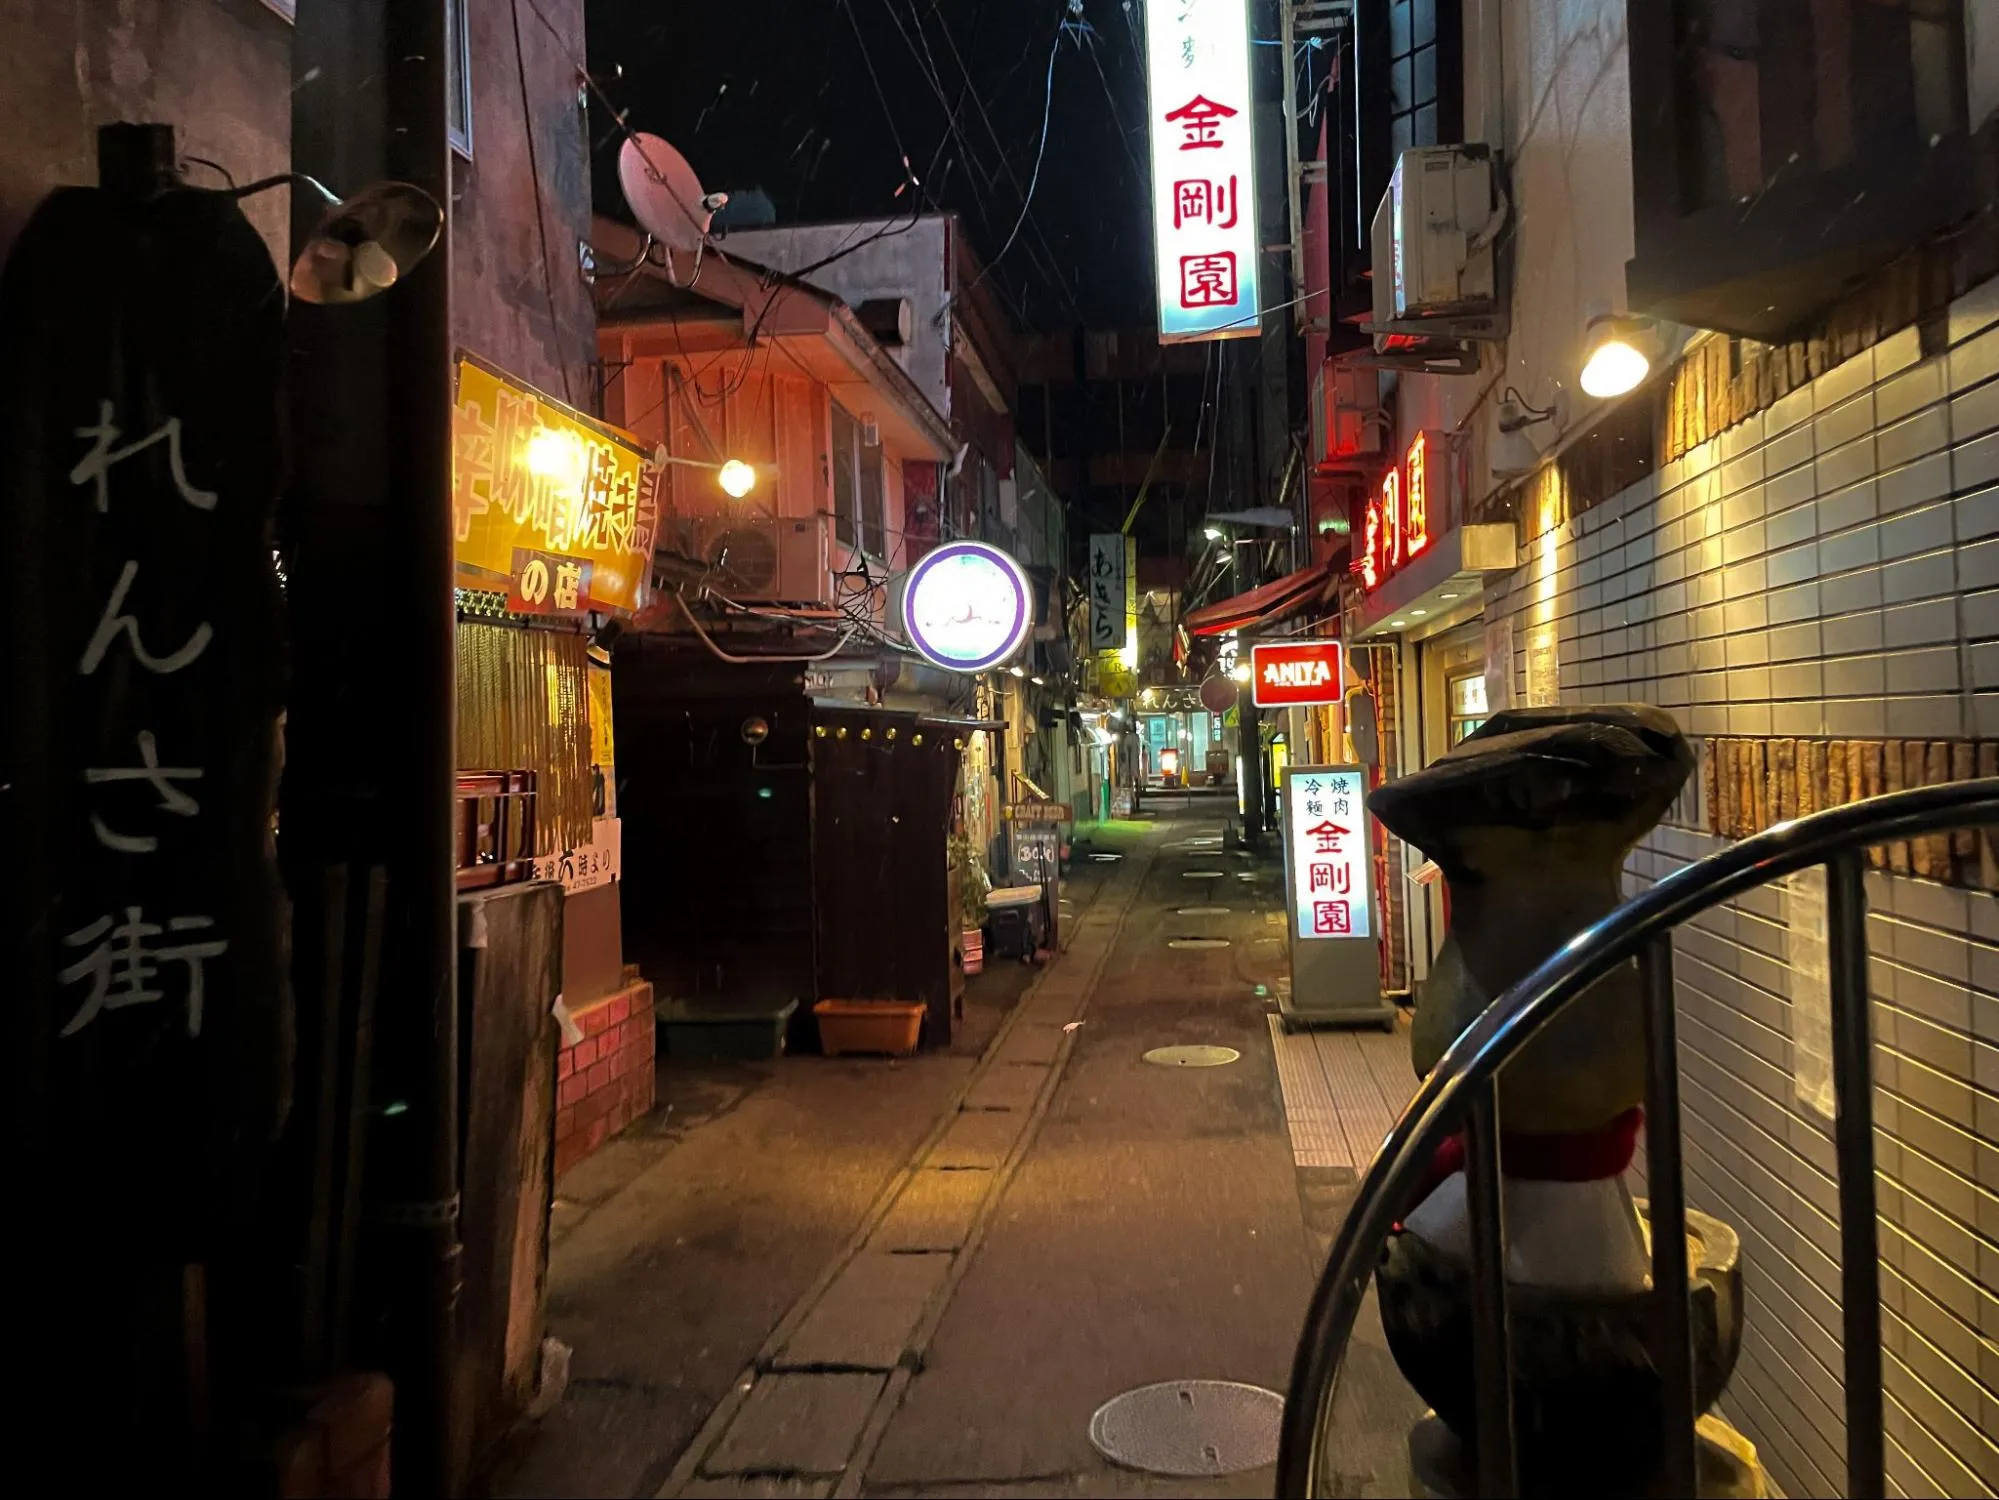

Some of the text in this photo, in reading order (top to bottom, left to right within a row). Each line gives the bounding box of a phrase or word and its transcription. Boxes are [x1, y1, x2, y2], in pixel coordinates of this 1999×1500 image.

[1165, 94, 1239, 309] 金剛園
[520, 559, 582, 610] の店
[1263, 661, 1332, 684] ANIYA
[59, 400, 228, 1037] れんさ街
[1142, 693, 1204, 709] れんさ
[1330, 777, 1350, 816] 焼肉
[1305, 820, 1352, 934] 金剛園
